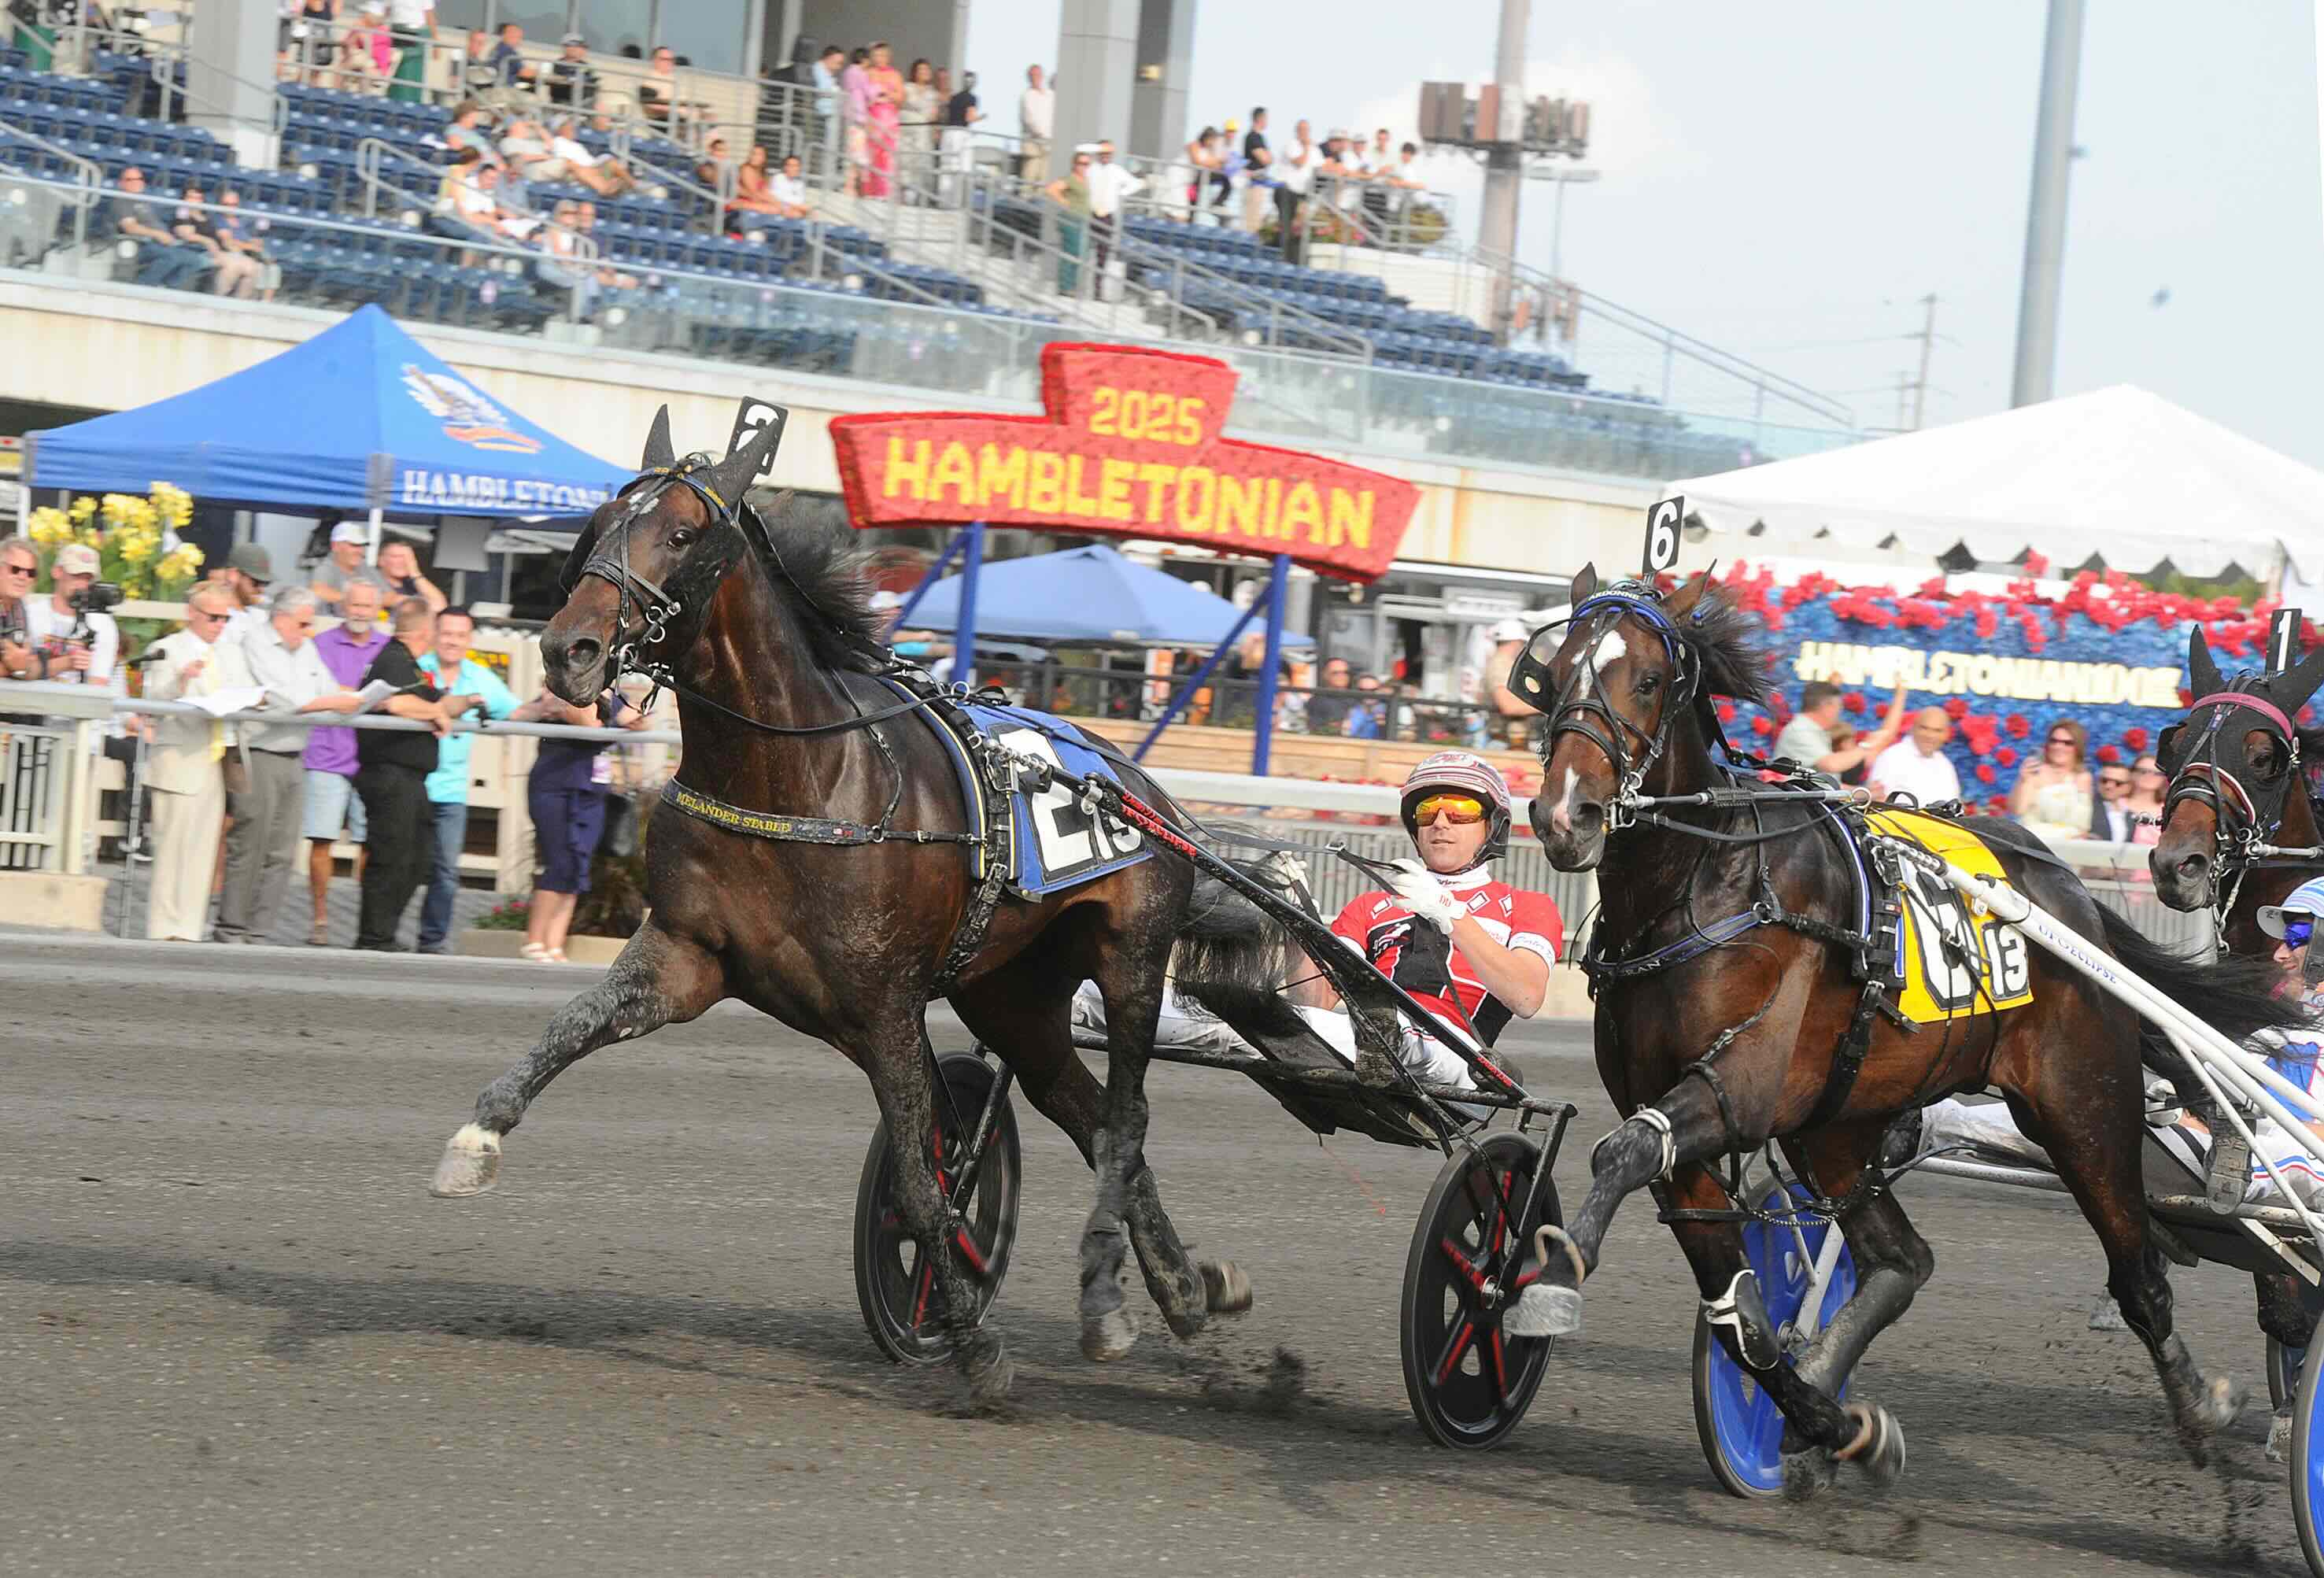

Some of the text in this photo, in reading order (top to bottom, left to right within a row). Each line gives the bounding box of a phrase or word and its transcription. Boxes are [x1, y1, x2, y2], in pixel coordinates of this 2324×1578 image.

[1090, 386, 1205, 445] 2025
[882, 434, 1375, 549] HAMBLETONIAN
[1650, 501, 1678, 571] 6
[2277, 610, 2293, 671] 1
[676, 792, 791, 833] MELANDER STABLE
[999, 728, 1094, 872] 2
[1897, 852, 2028, 1000] 6 13
[2069, 948, 2117, 985] ECLIPSE
